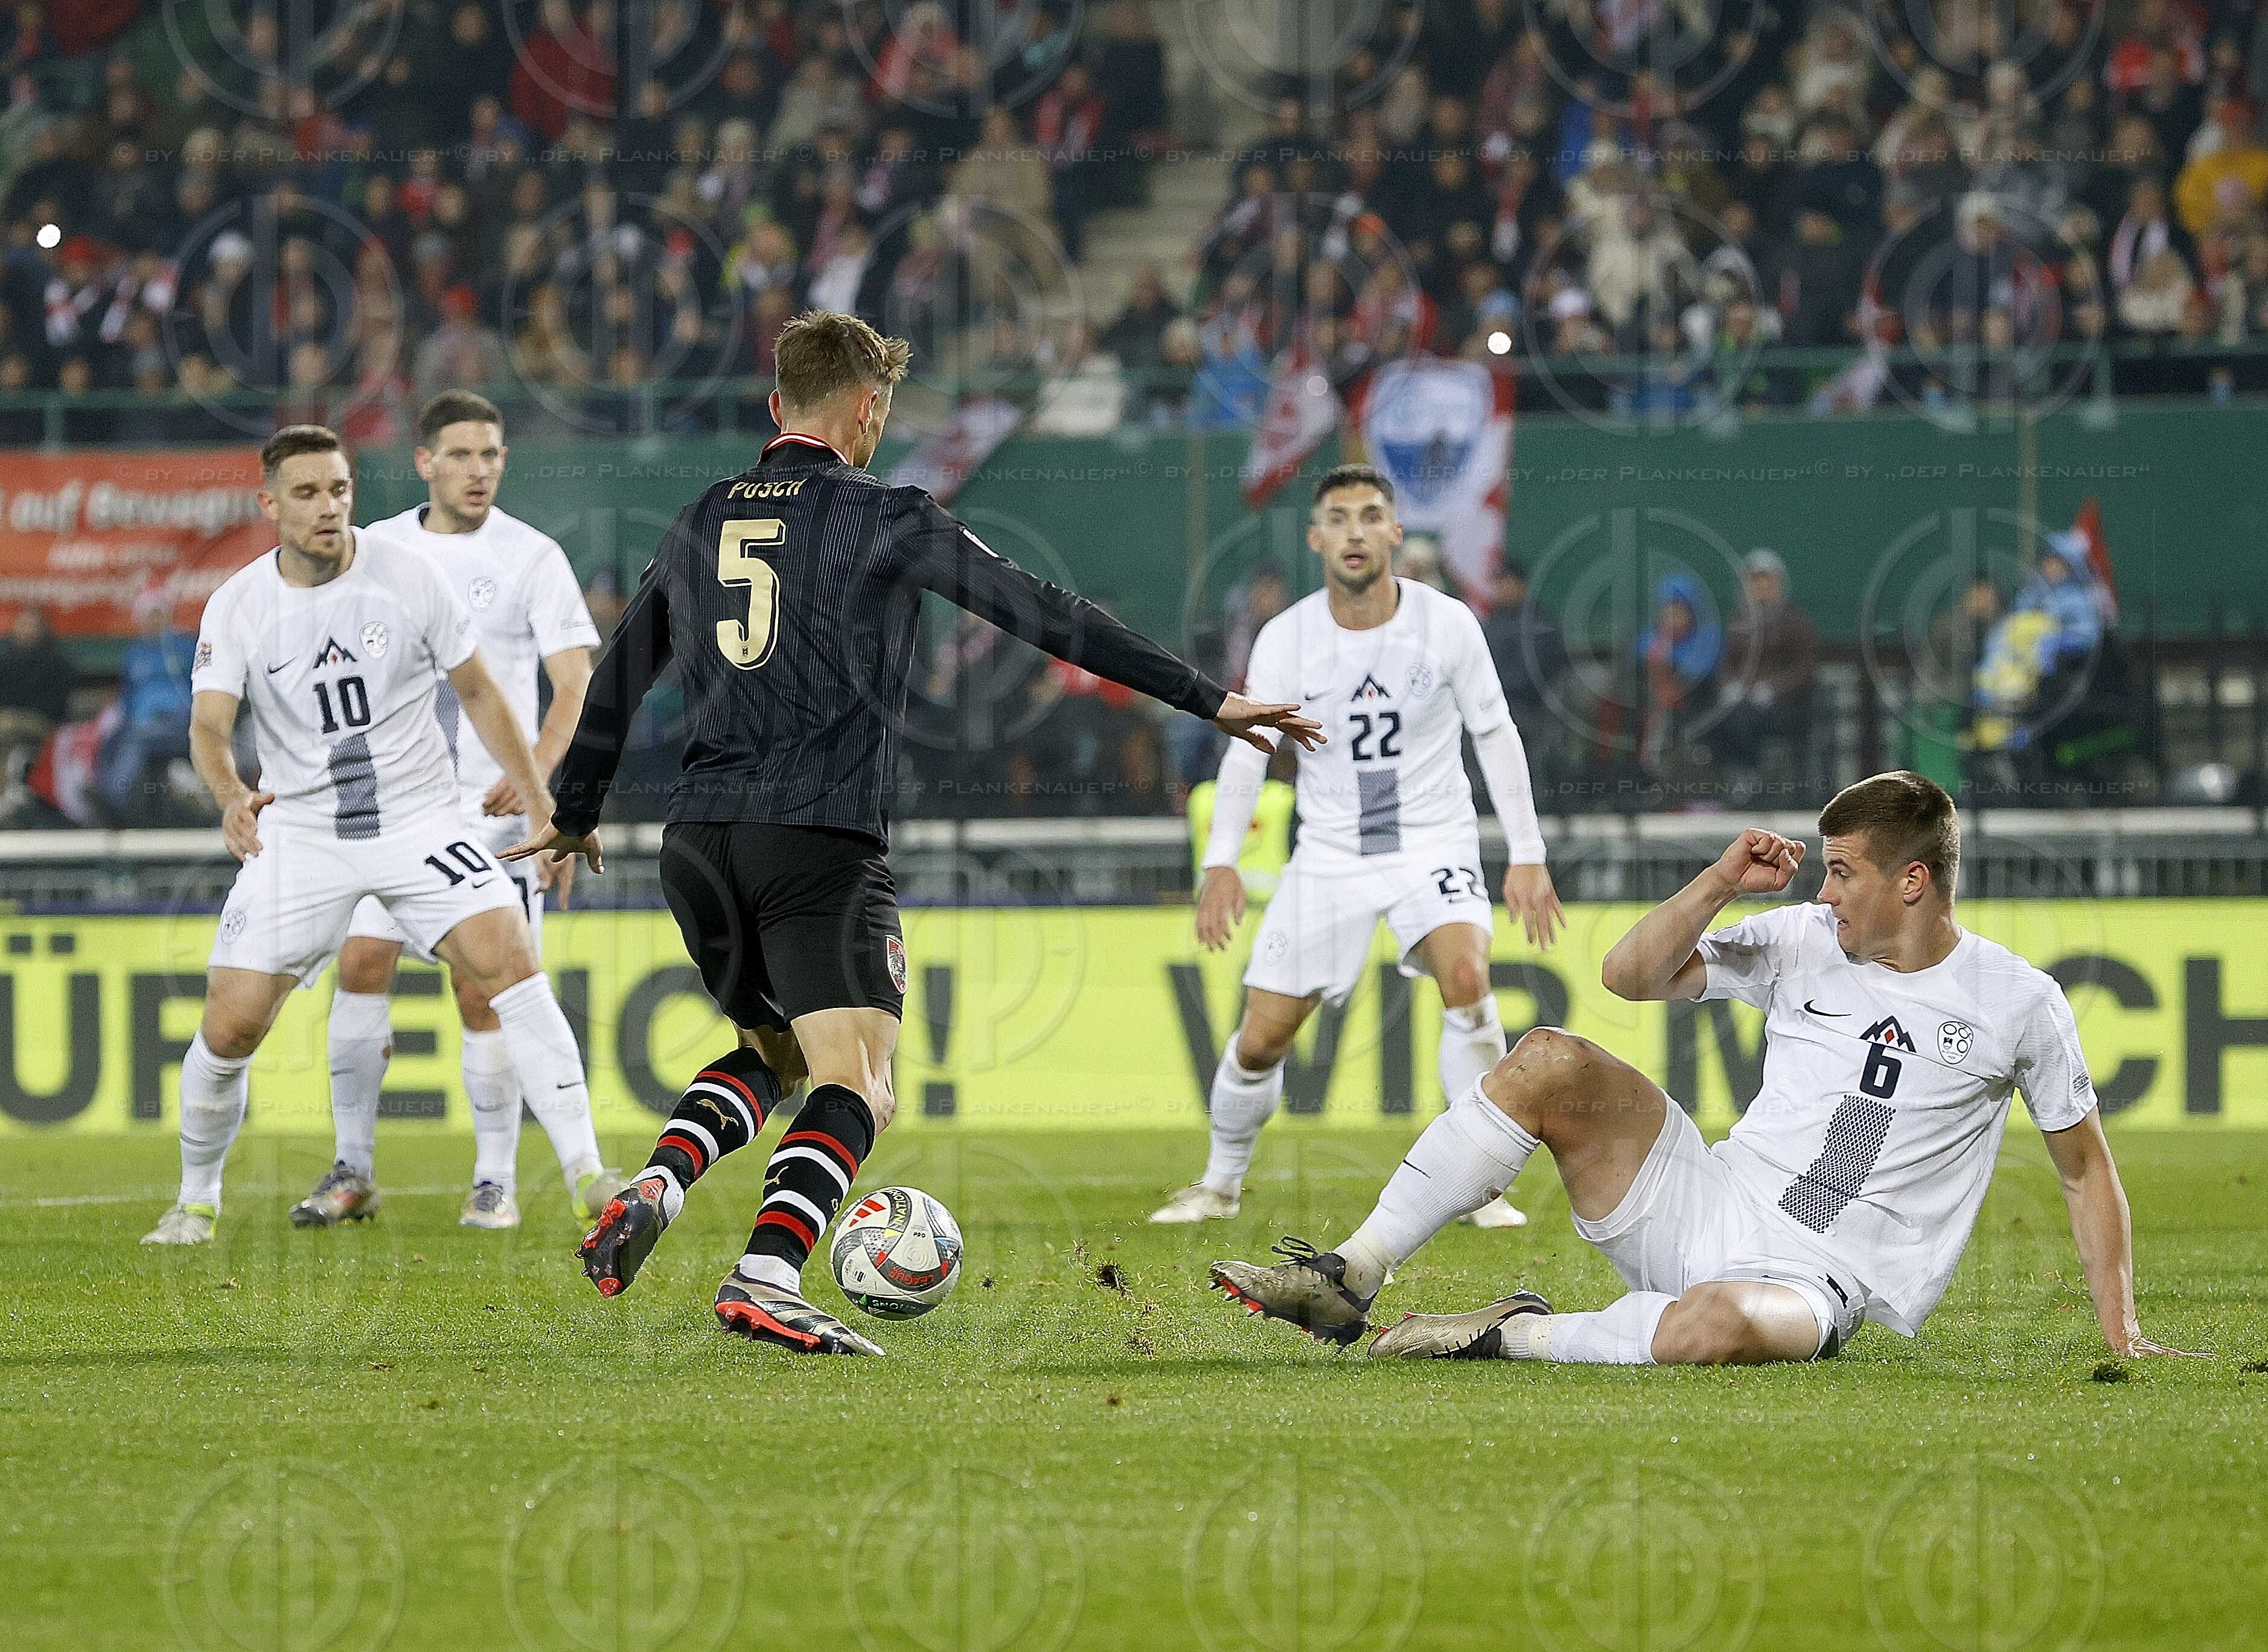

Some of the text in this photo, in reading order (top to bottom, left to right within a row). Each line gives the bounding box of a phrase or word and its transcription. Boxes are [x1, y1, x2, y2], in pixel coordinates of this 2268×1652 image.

[717, 518, 786, 671] 5
[313, 675, 371, 734] 10
[1349, 712, 1401, 761] 22
[424, 841, 493, 885] 10
[1859, 1041, 1902, 1099] 6
